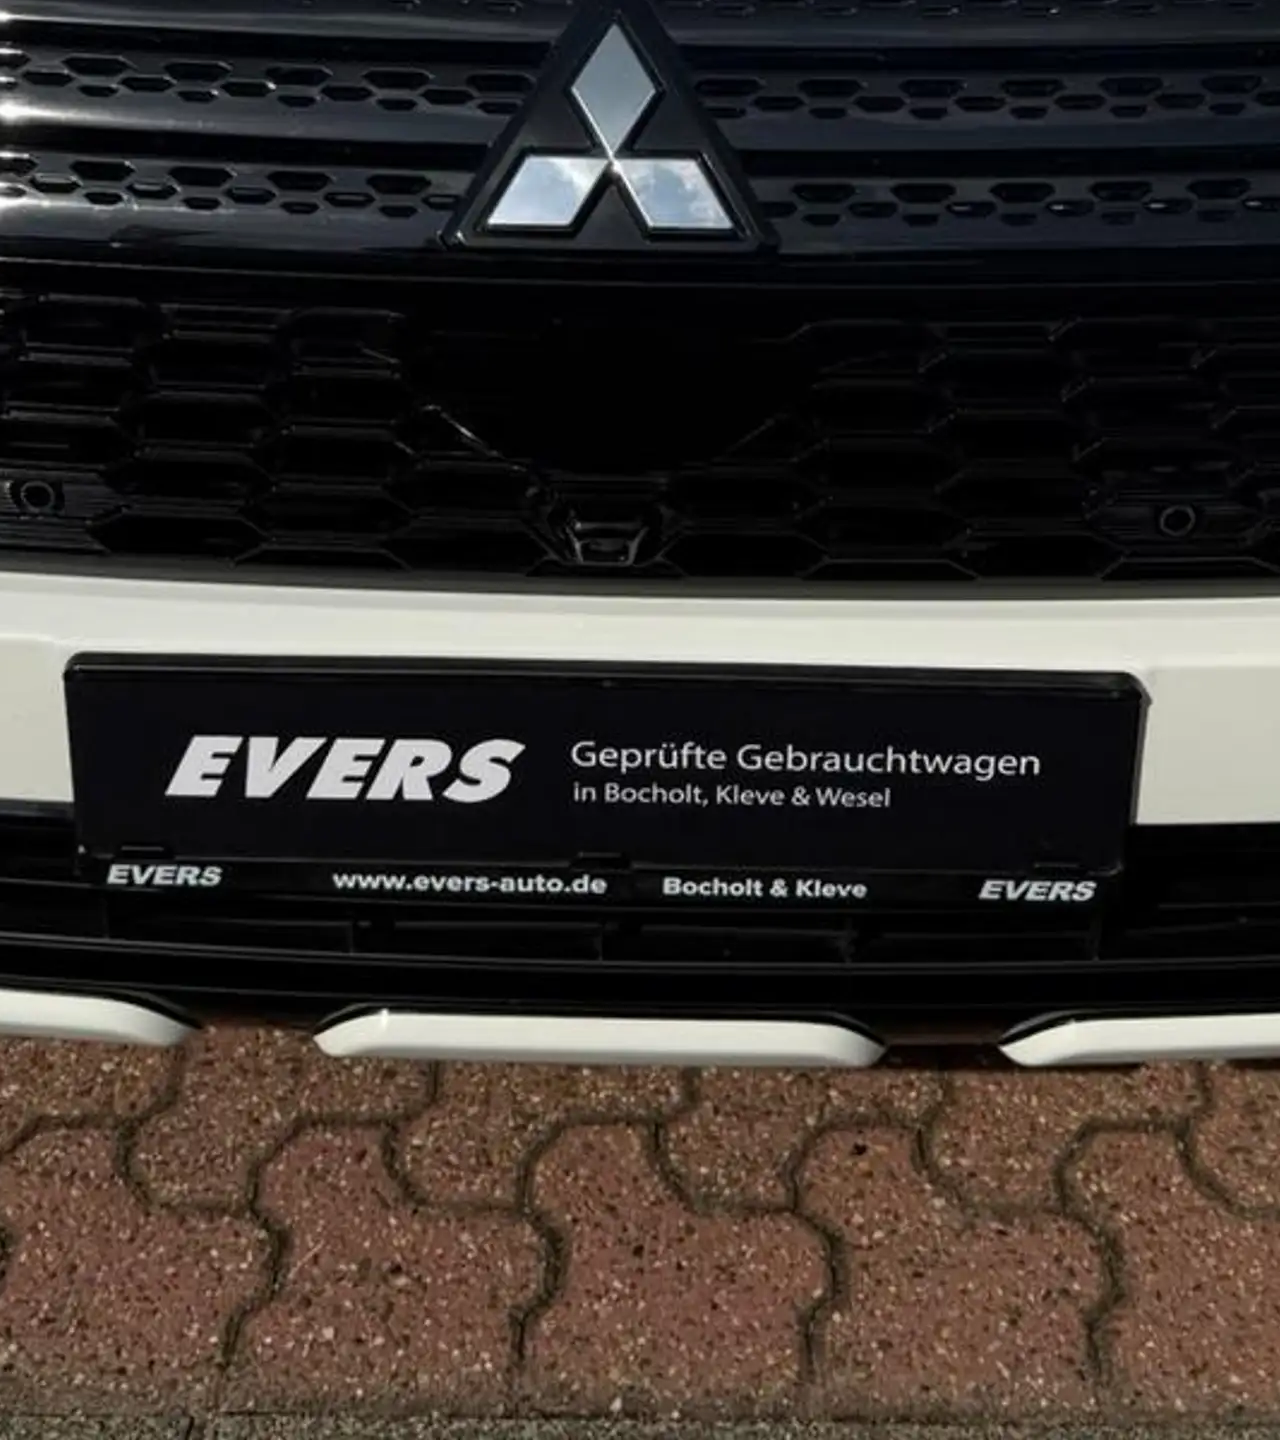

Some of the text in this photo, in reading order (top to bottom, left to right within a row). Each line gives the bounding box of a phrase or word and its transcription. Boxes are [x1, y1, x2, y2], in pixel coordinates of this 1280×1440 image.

[165, 734, 1042, 804] EVERS Geprüfte Gebrauchtwagen
[572, 782, 892, 808] in Bocholt, Kleve & Wesel
[106, 864, 223, 887] EVERS
[332, 870, 1098, 903] www.evers-auto.de Bocholt & Kleve EVERS
